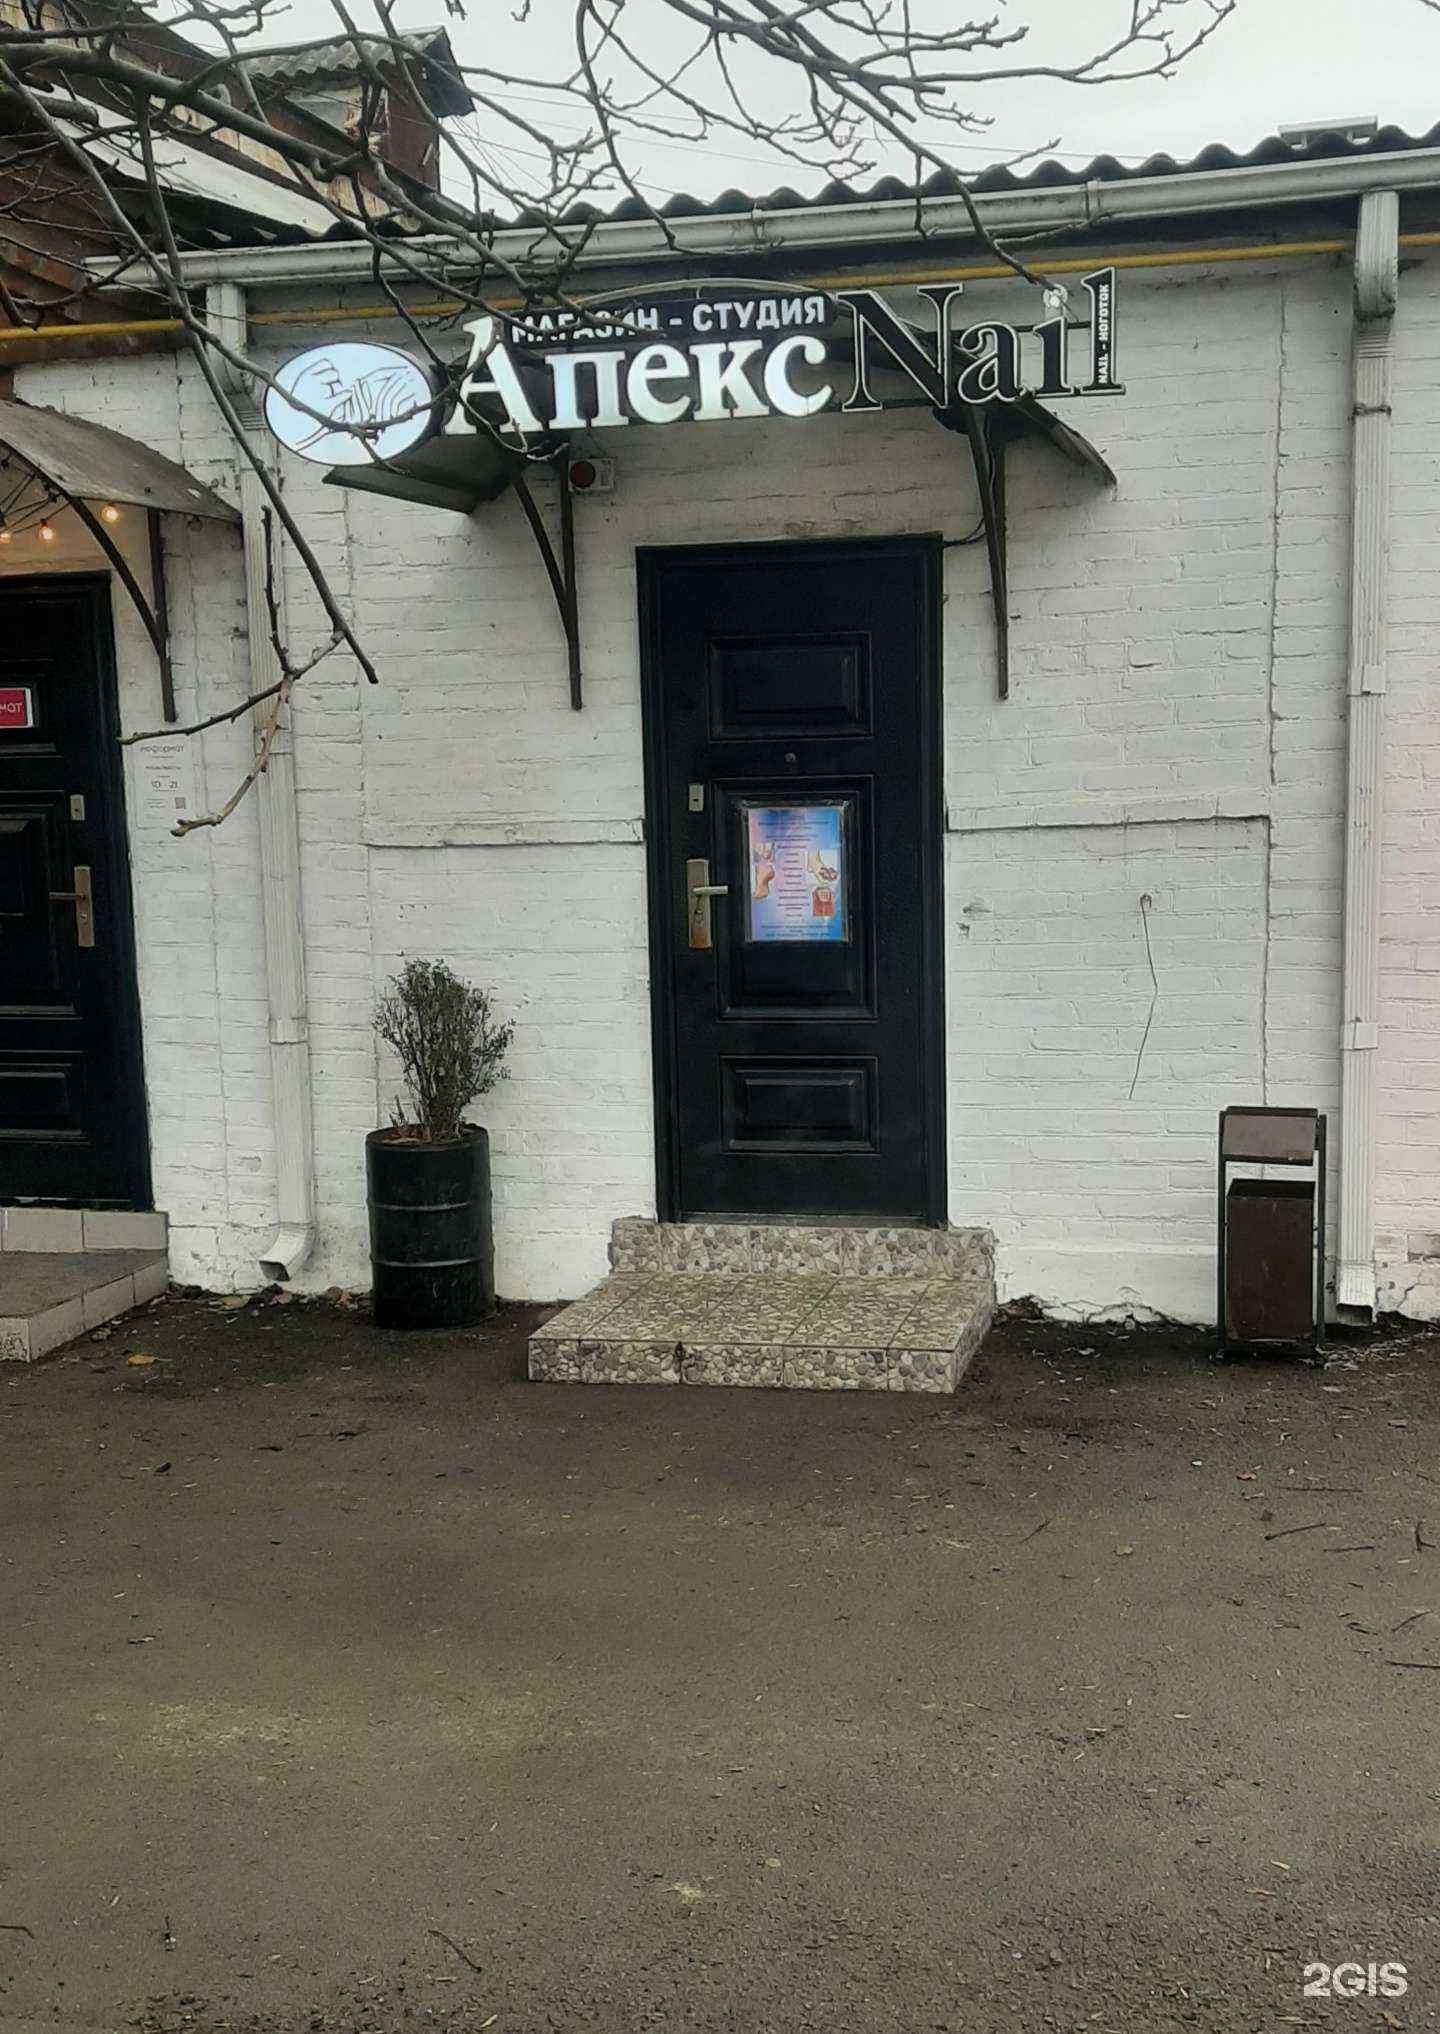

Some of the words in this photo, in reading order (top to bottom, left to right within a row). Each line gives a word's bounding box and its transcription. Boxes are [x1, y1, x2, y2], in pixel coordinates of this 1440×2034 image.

[692, 296, 826, 332] СТУДИЯ
[836, 266, 1126, 411] Nail
[1098, 284, 1109, 341] НОГОТОК
[444, 315, 833, 436] Апекс
